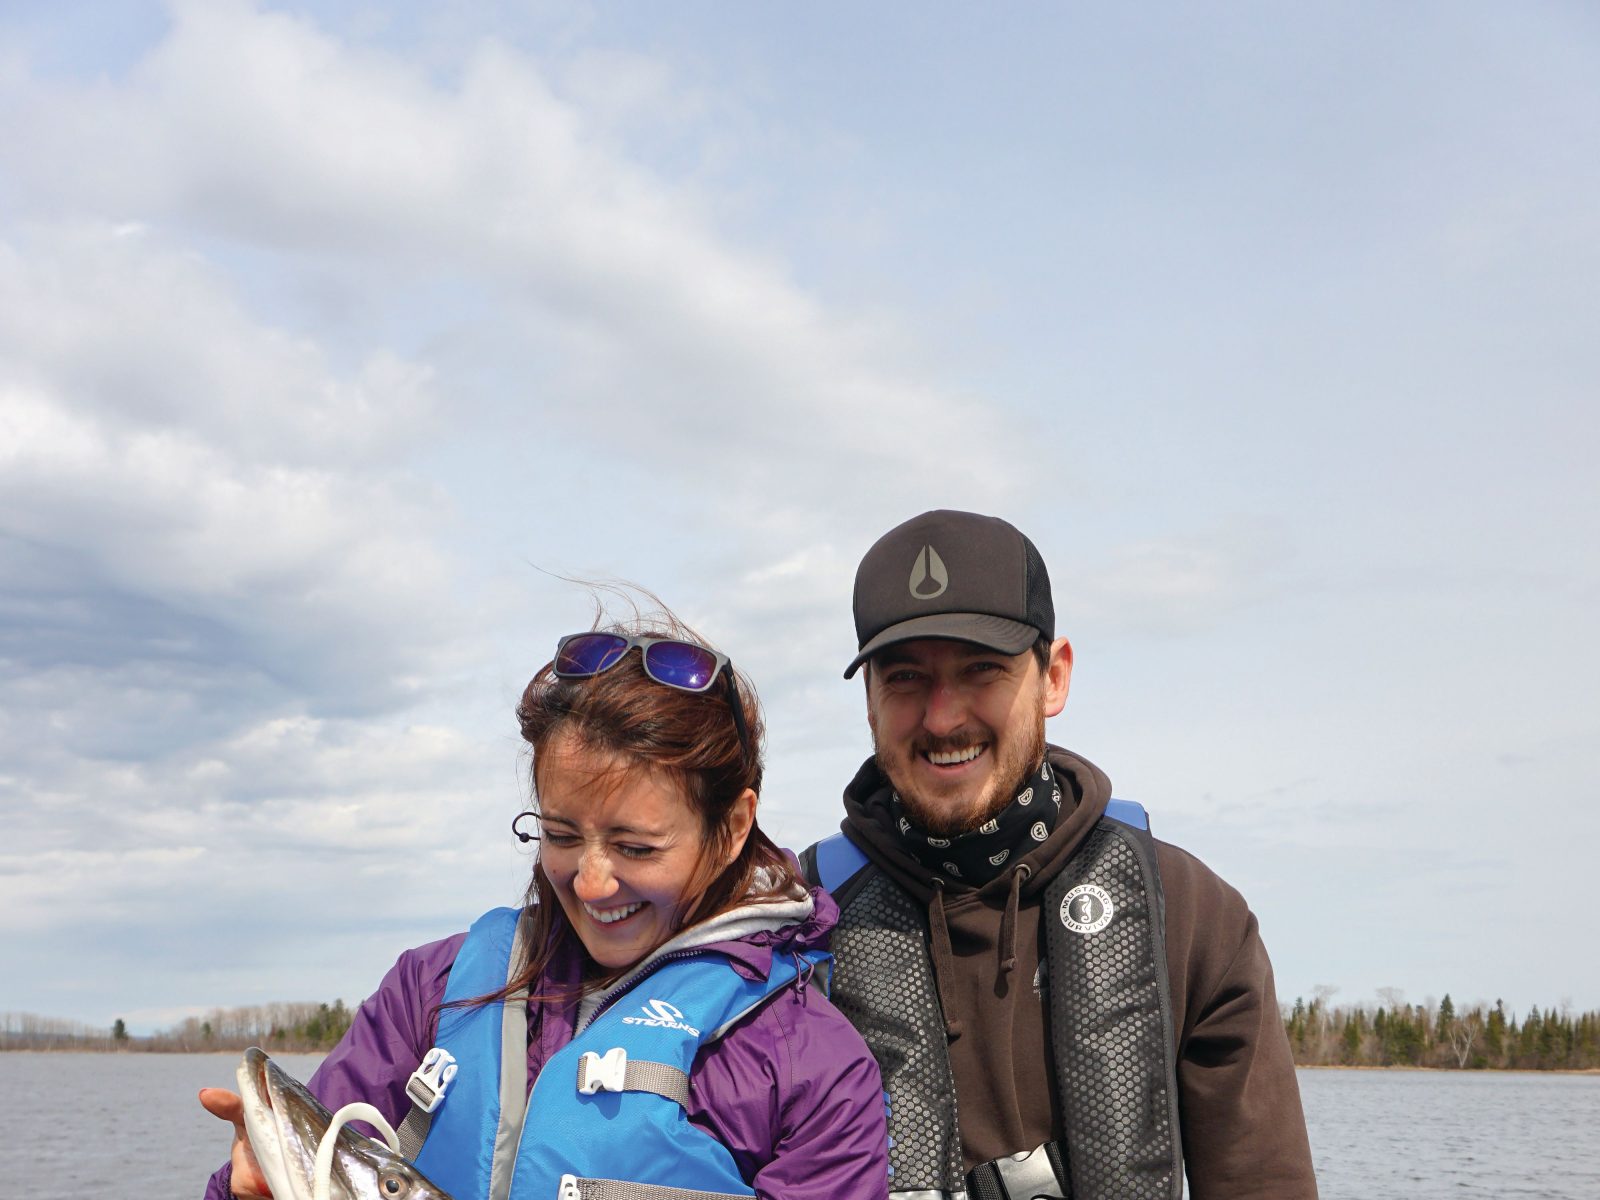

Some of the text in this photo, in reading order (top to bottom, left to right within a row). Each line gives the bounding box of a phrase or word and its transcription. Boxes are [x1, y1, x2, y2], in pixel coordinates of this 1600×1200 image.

[1062, 887, 1109, 909] MUSTANG
[1062, 910, 1112, 931] SURVIVAL
[621, 1016, 700, 1038] STEARNS
